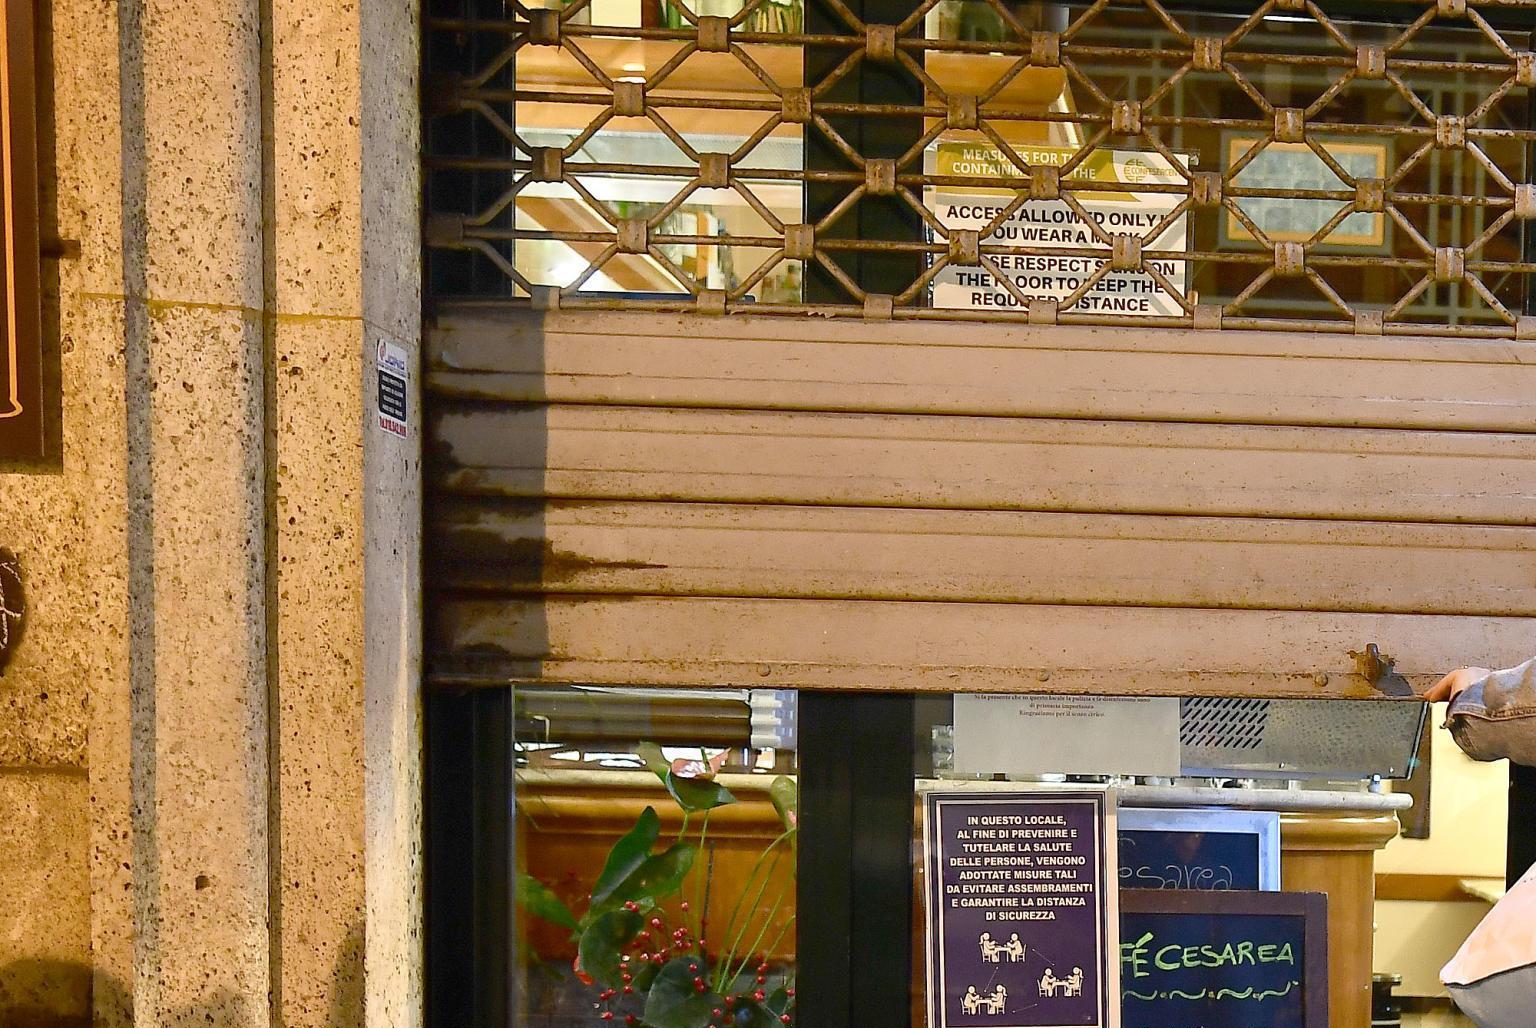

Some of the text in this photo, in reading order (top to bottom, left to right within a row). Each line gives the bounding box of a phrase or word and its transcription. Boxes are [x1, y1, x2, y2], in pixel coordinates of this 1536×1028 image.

[964, 149, 1029, 163] MEASUS
[1033, 152, 1058, 163] FOR
[953, 162, 1096, 180] CONTAINM THE
[1019, 209, 1105, 225] ALLOWD
[1109, 212, 1157, 227] ONLY
[1021, 228, 1072, 243] WEAR
[1076, 231, 1087, 244] A
[1015, 257, 1093, 273] RESPECT
[956, 273, 990, 286] THE
[1054, 277, 1079, 290] TO
[1130, 280, 1164, 293] THE
[968, 816, 1066, 826] IN QUESTO LOCALE,
[957, 830, 1077, 839] AL FINE DI PREVENIRE E
[963, 843, 1072, 852] TUTELARE LA SALUTE
[950, 857, 1085, 867] DELLE PERSONE, VENGONO
[960, 870, 1076, 879] ADOTTATE MISURE TALI
[947, 884, 1092, 893] DA EVITARE ASSEMBRAMENTI
[952, 897, 1085, 907] E GARANTIRE LA DISTANZA
[986, 911, 1055, 920] DI SICUREZZA
[1154, 941, 1294, 970] CESAREA
